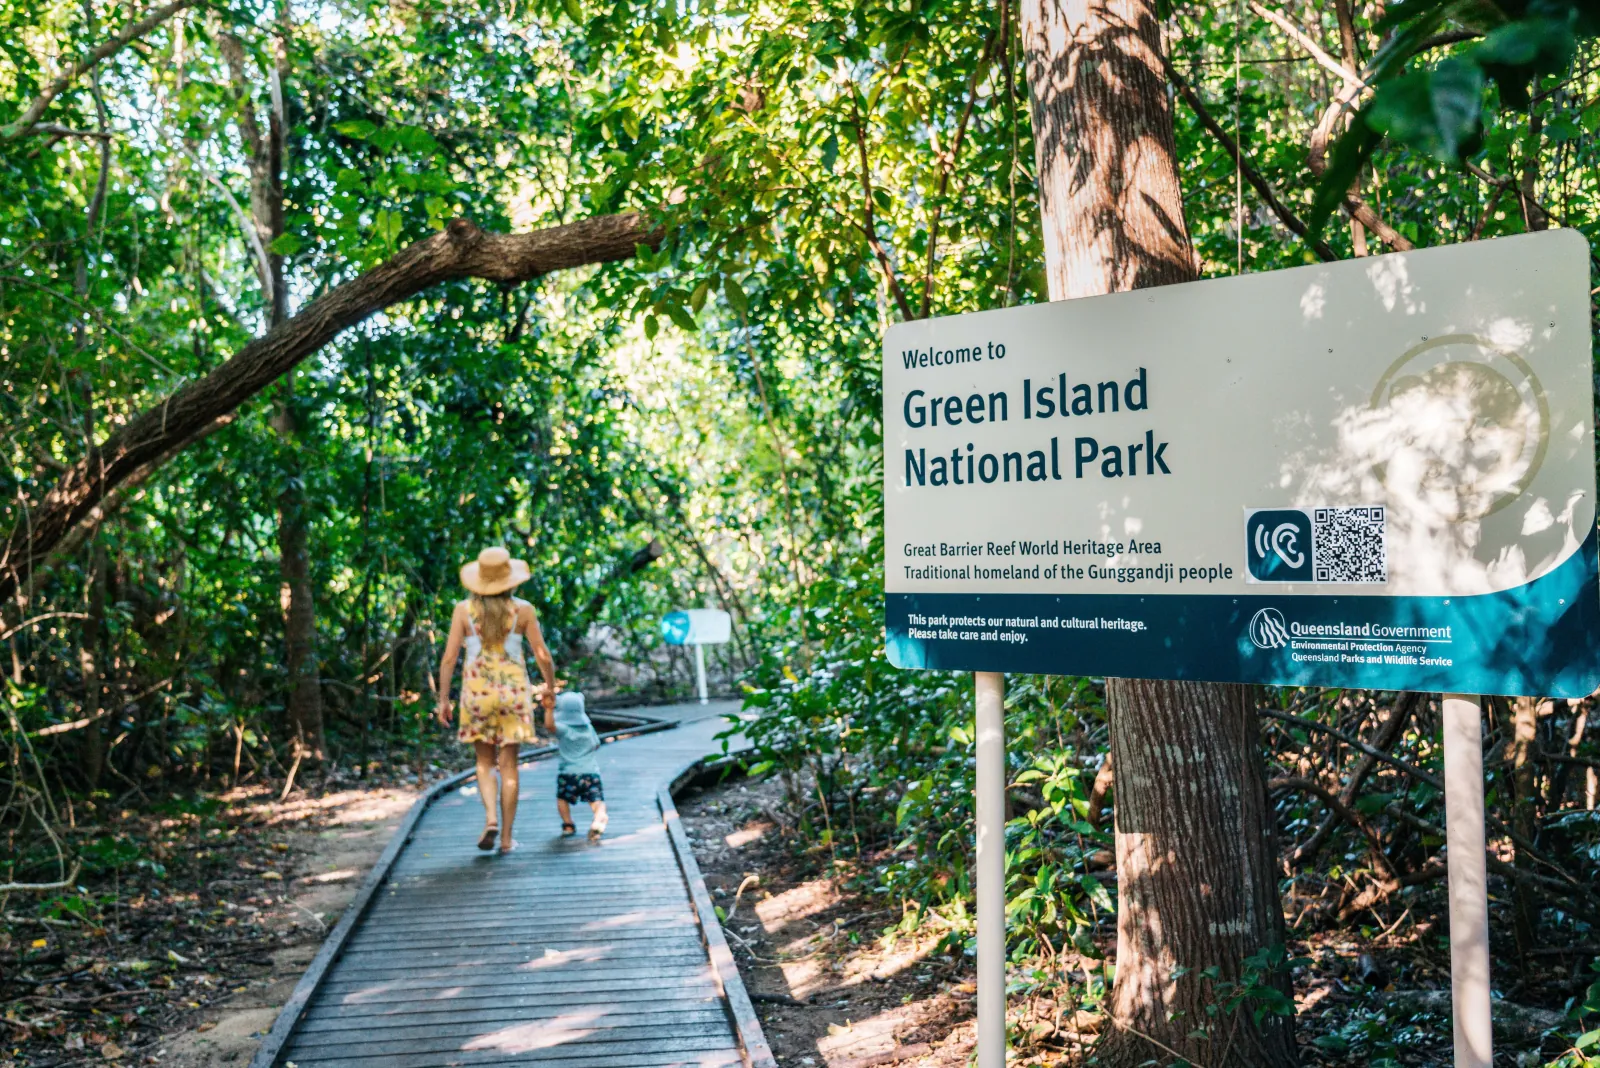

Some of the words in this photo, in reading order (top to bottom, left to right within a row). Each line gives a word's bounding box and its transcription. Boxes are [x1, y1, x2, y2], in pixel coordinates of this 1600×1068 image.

[903, 346, 982, 369] Welcome
[988, 341, 1006, 360] to
[903, 389, 1008, 428] Green
[1023, 367, 1148, 419] Island
[905, 436, 1062, 487] National
[1075, 429, 1171, 478] Park
[904, 543, 936, 556] Great
[940, 542, 983, 557] Barrier
[987, 540, 1016, 556] Reef
[1019, 540, 1059, 555] World
[1063, 539, 1124, 557] Heritage
[1128, 539, 1161, 554] Area
[904, 565, 970, 579] Traditional
[974, 564, 1040, 580] homeland
[1044, 564, 1058, 579] of
[1061, 564, 1084, 579] the
[1088, 563, 1174, 583] Gunggandji
[1179, 561, 1233, 583] people
[908, 614, 926, 625] This
[928, 614, 948, 627] park
[949, 615, 986, 628] protects
[988, 617, 1004, 626] our
[1005, 616, 1039, 628] natural
[1040, 617, 1059, 628] and
[1061, 617, 1099, 629] cultural
[1101, 618, 1147, 632] heritage.
[1291, 621, 1370, 636] Queensland
[1371, 624, 1451, 638] Government
[908, 629, 937, 640] Please
[938, 629, 958, 640] take
[960, 631, 979, 641] care
[980, 630, 998, 641] and
[1000, 631, 1028, 644] enjoy.
[1291, 641, 1349, 651] Environmental
[1350, 642, 1394, 653] Protection
[1395, 643, 1427, 655] Agency
[1291, 652, 1339, 663] Queensland
[1341, 653, 1365, 664] Parks
[1366, 654, 1382, 664] and
[1384, 655, 1417, 666] Wildlife
[1419, 656, 1452, 666] Service
